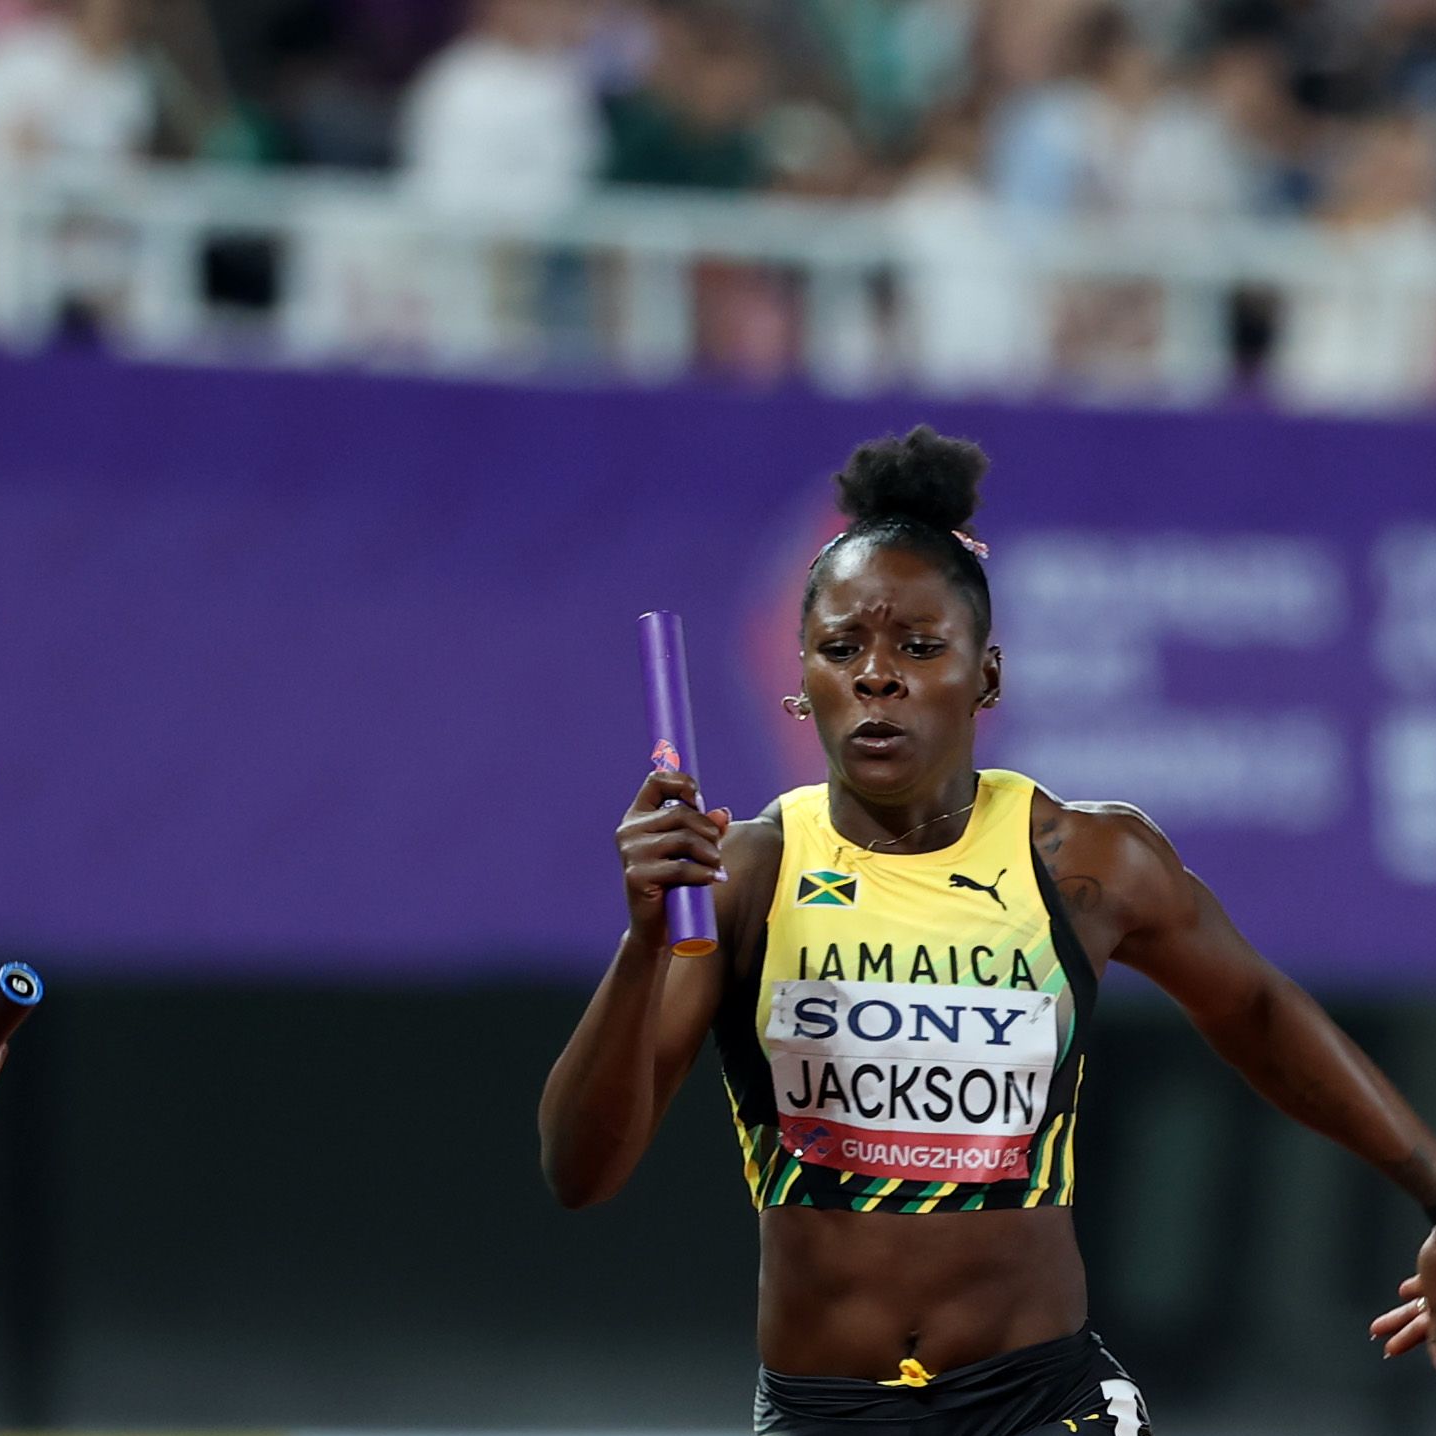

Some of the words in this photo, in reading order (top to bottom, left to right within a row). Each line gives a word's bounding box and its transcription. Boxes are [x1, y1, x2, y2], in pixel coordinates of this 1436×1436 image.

[798, 941, 1038, 992] JAMAICA
[793, 996, 1027, 1046] SONY
[785, 1059, 1037, 1126] JACKSON
[841, 1137, 1001, 1170] GUANGZHOU
